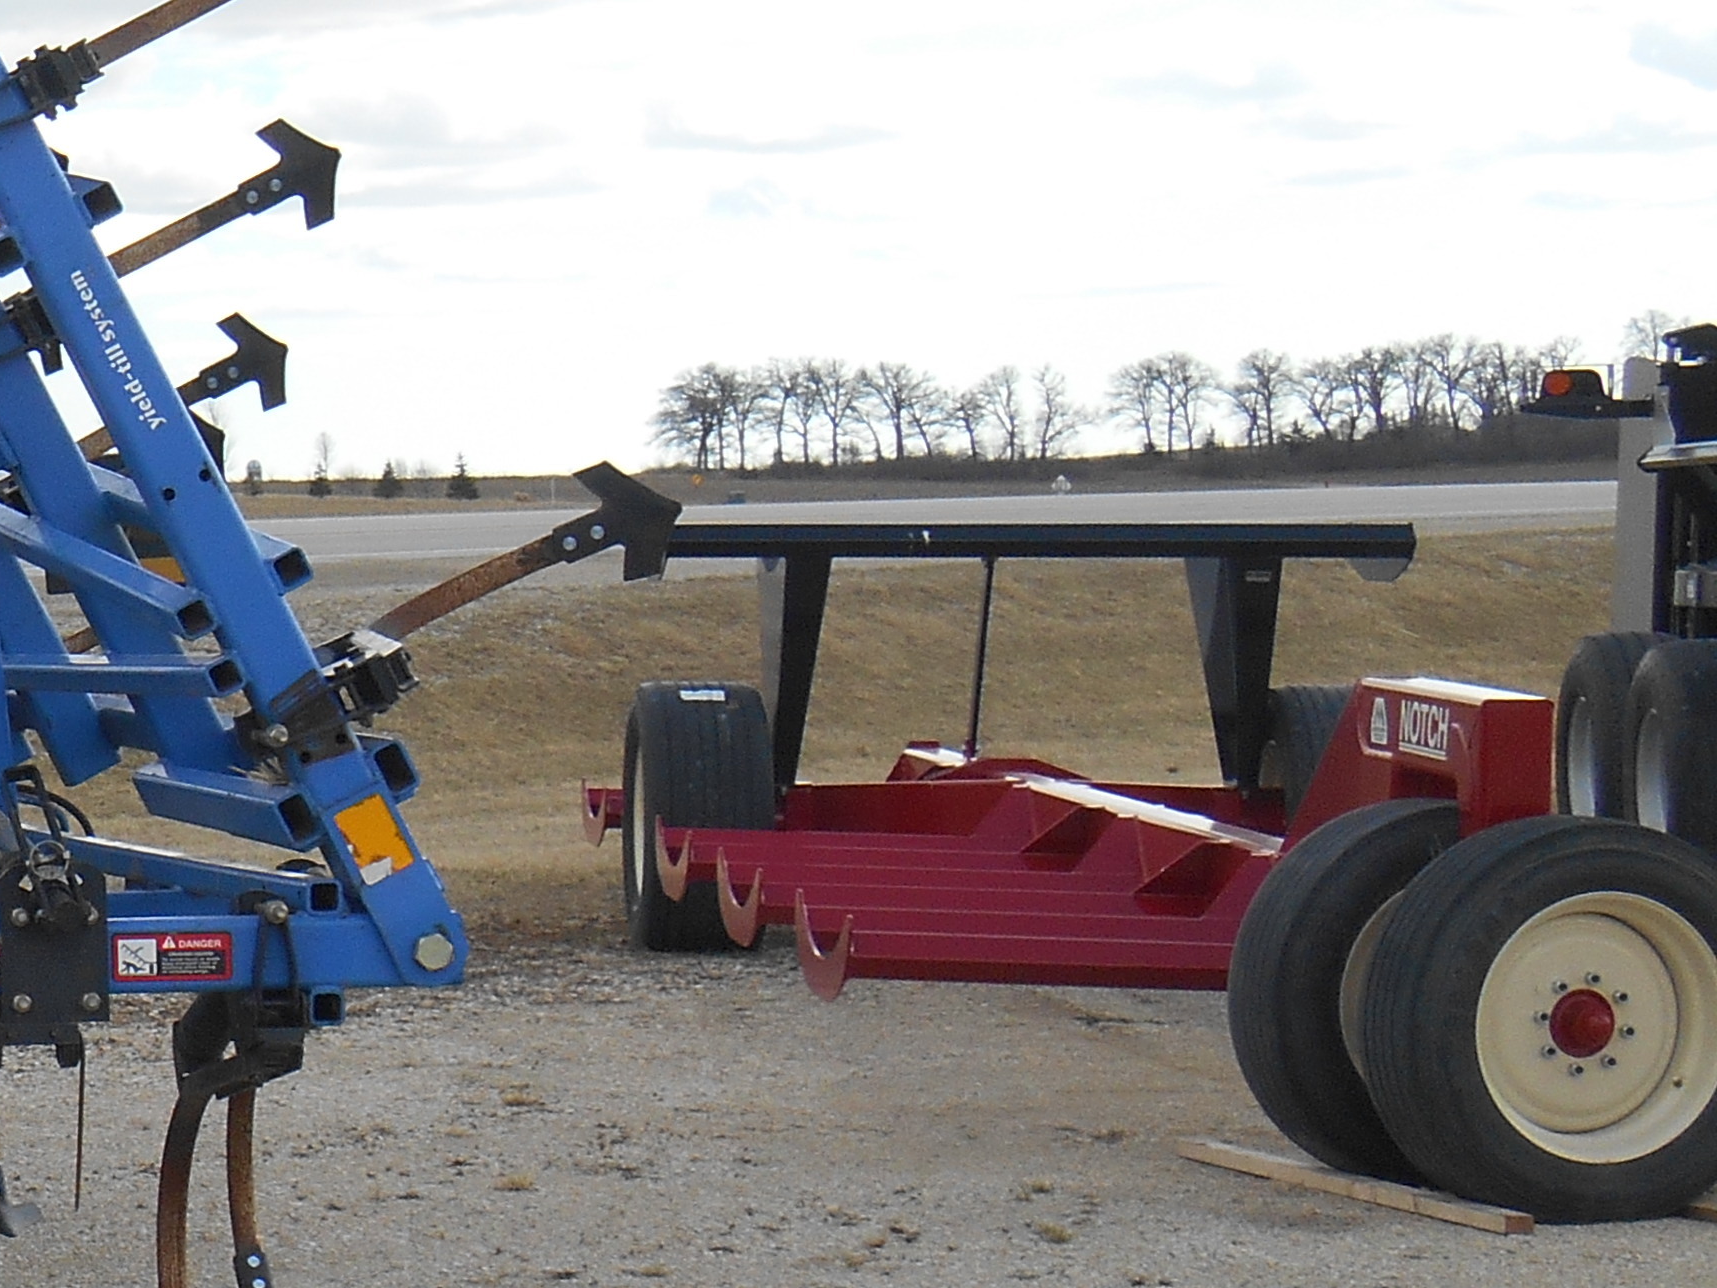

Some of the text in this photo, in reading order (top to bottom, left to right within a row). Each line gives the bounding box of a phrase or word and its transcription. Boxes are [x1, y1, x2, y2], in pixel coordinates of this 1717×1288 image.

[70, 270, 167, 430] yield-till system
[1399, 699, 1449, 750] NOTCH
[178, 939, 222, 949] DANGER
